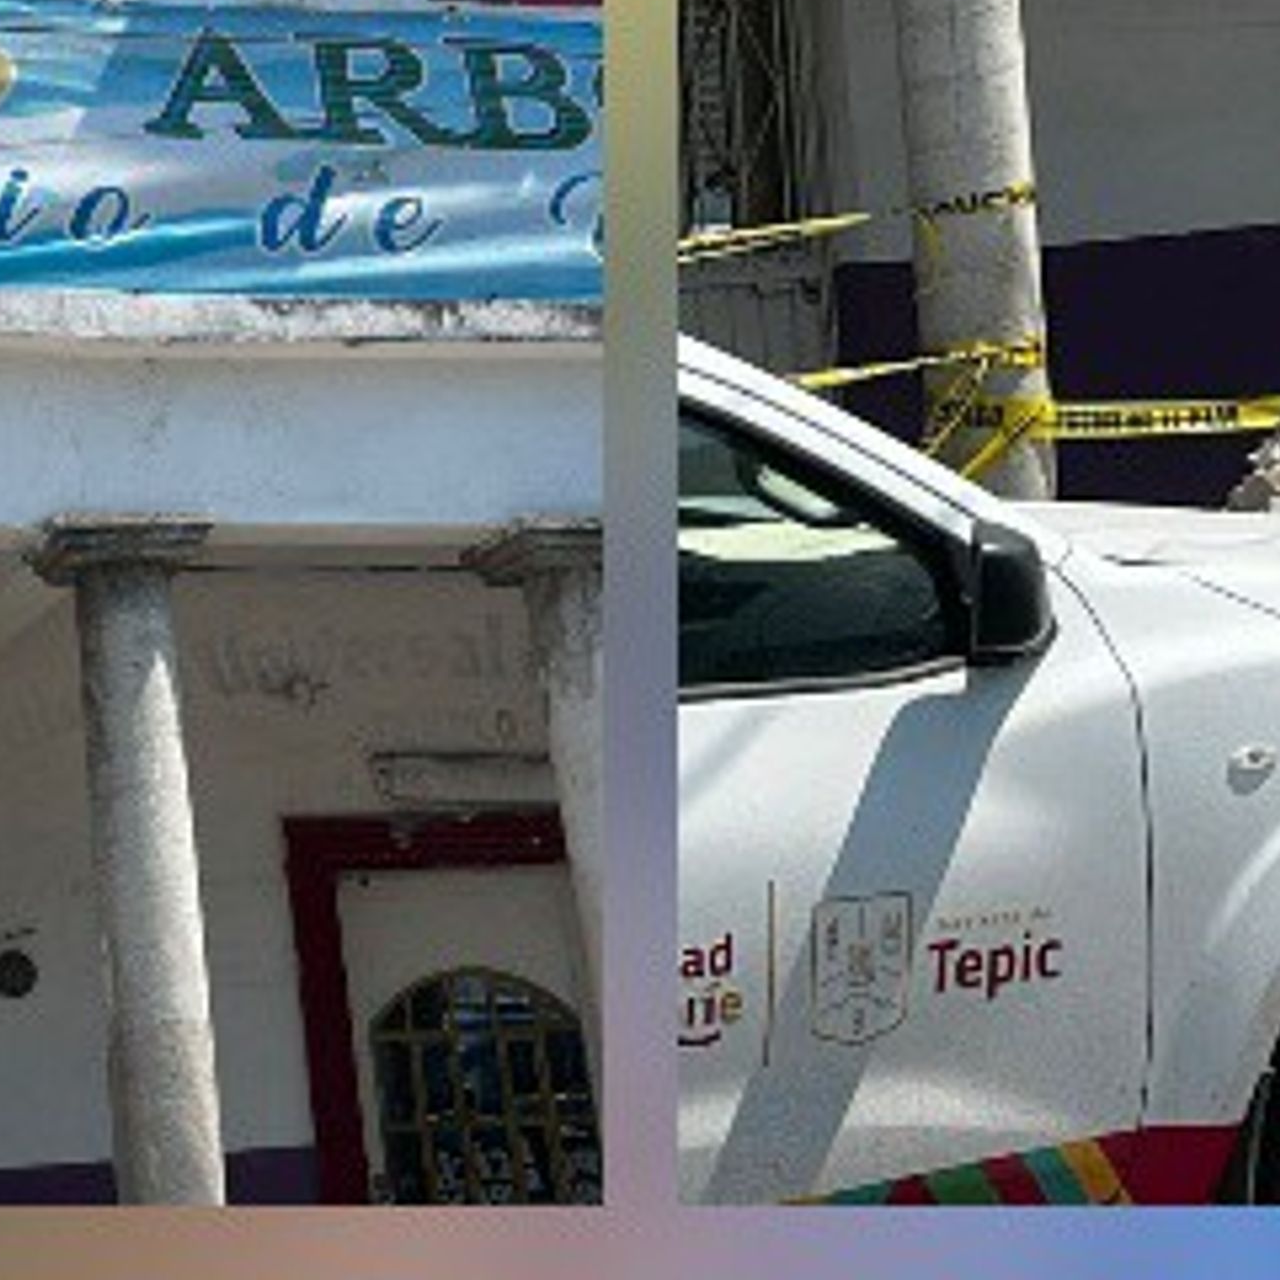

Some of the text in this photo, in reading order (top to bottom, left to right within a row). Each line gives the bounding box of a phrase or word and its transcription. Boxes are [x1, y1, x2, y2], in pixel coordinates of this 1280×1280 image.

[144, 26, 603, 152] ARB
[257, 165, 446, 258] de
[680, 930, 733, 978] ad
[926, 928, 1064, 1002] Tepic
